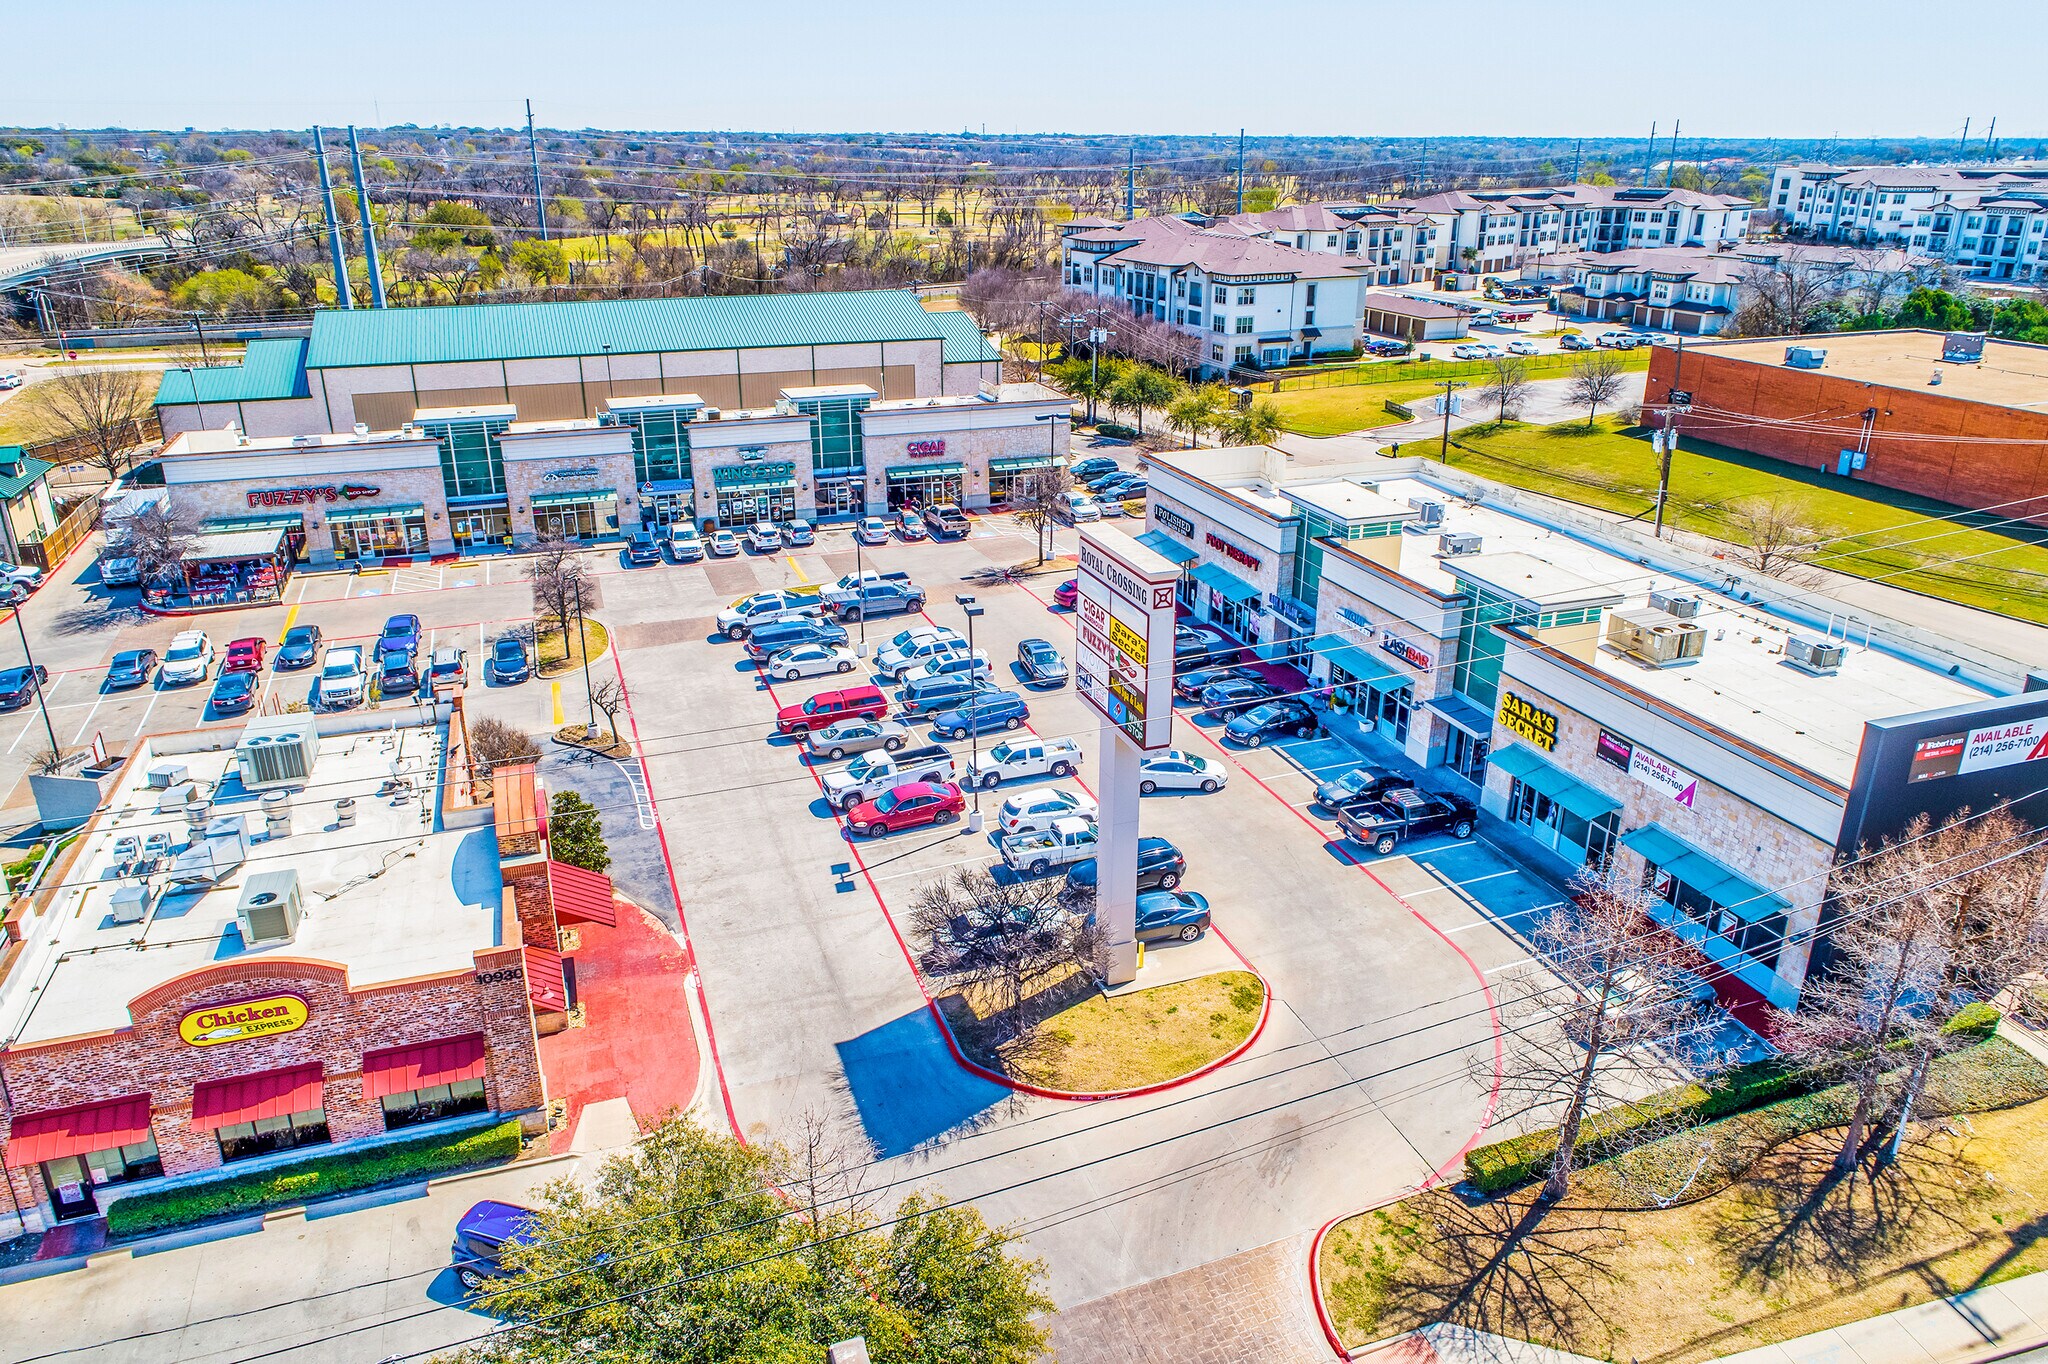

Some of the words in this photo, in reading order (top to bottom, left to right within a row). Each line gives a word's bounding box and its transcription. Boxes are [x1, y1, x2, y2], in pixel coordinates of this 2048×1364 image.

[908, 441, 945, 453] CIGAR
[712, 466, 752, 480] WING
[755, 462, 796, 478] STOP
[246, 487, 338, 508] FUZZY'S
[1158, 507, 1191, 533] POLISHED
[1206, 533, 1226, 553] FOOT
[1225, 542, 1260, 571] THERAPY
[1081, 546, 1104, 575] ROYAL
[1107, 563, 1148, 605] CROSSING
[1083, 598, 1105, 624] CIGAR
[1084, 612, 1104, 632] WAREHOUSE
[1082, 624, 1115, 663] FUZZY'S
[1111, 631, 1146, 664] Secret
[1114, 622, 1146, 653] Sara's
[1128, 710, 1144, 731] WING
[1502, 692, 1555, 733] SARA'S
[1127, 723, 1144, 742] STOP
[1498, 709, 1554, 752] SECRET
[1950, 738, 1964, 746] Lynn
[1972, 724, 2034, 745] AVAILABLE
[1969, 745, 1993, 759] (214)
[1995, 736, 2040, 753] 256-7100
[1633, 760, 1650, 775] (214)
[1651, 769, 1684, 792] 256-7100
[1635, 751, 1677, 779] AVAILABLE
[475, 968, 523, 985] 10930
[196, 1004, 289, 1029] Chicken
[246, 1018, 294, 1032] EXPRESS
